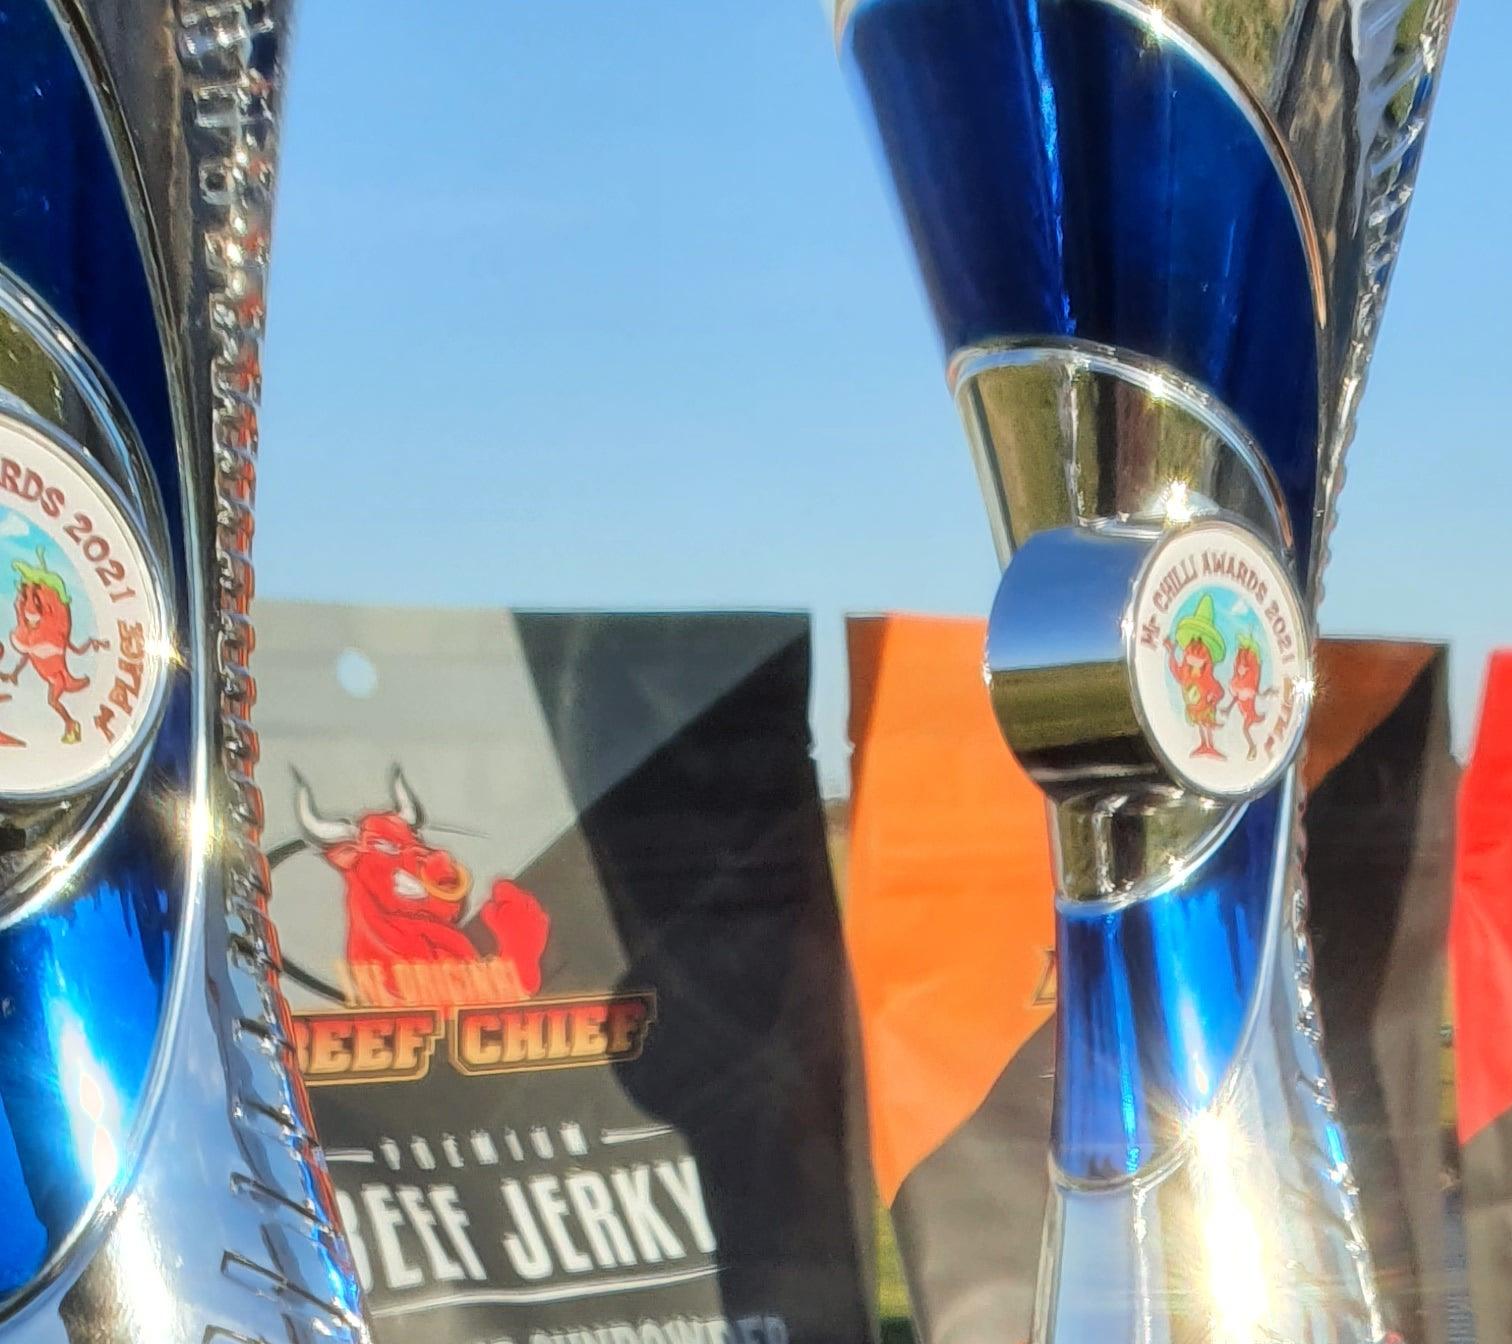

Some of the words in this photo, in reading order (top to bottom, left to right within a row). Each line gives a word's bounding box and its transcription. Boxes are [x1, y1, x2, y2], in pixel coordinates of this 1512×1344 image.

[0, 457, 65, 519] RDS
[62, 511, 136, 604] 2021
[1152, 554, 1199, 614] CHILLI
[1201, 550, 1268, 607] AWARDS
[1264, 600, 1296, 665] 2021
[462, 1000, 647, 1067] CHIEF
[500, 1154, 718, 1282] JERKY
